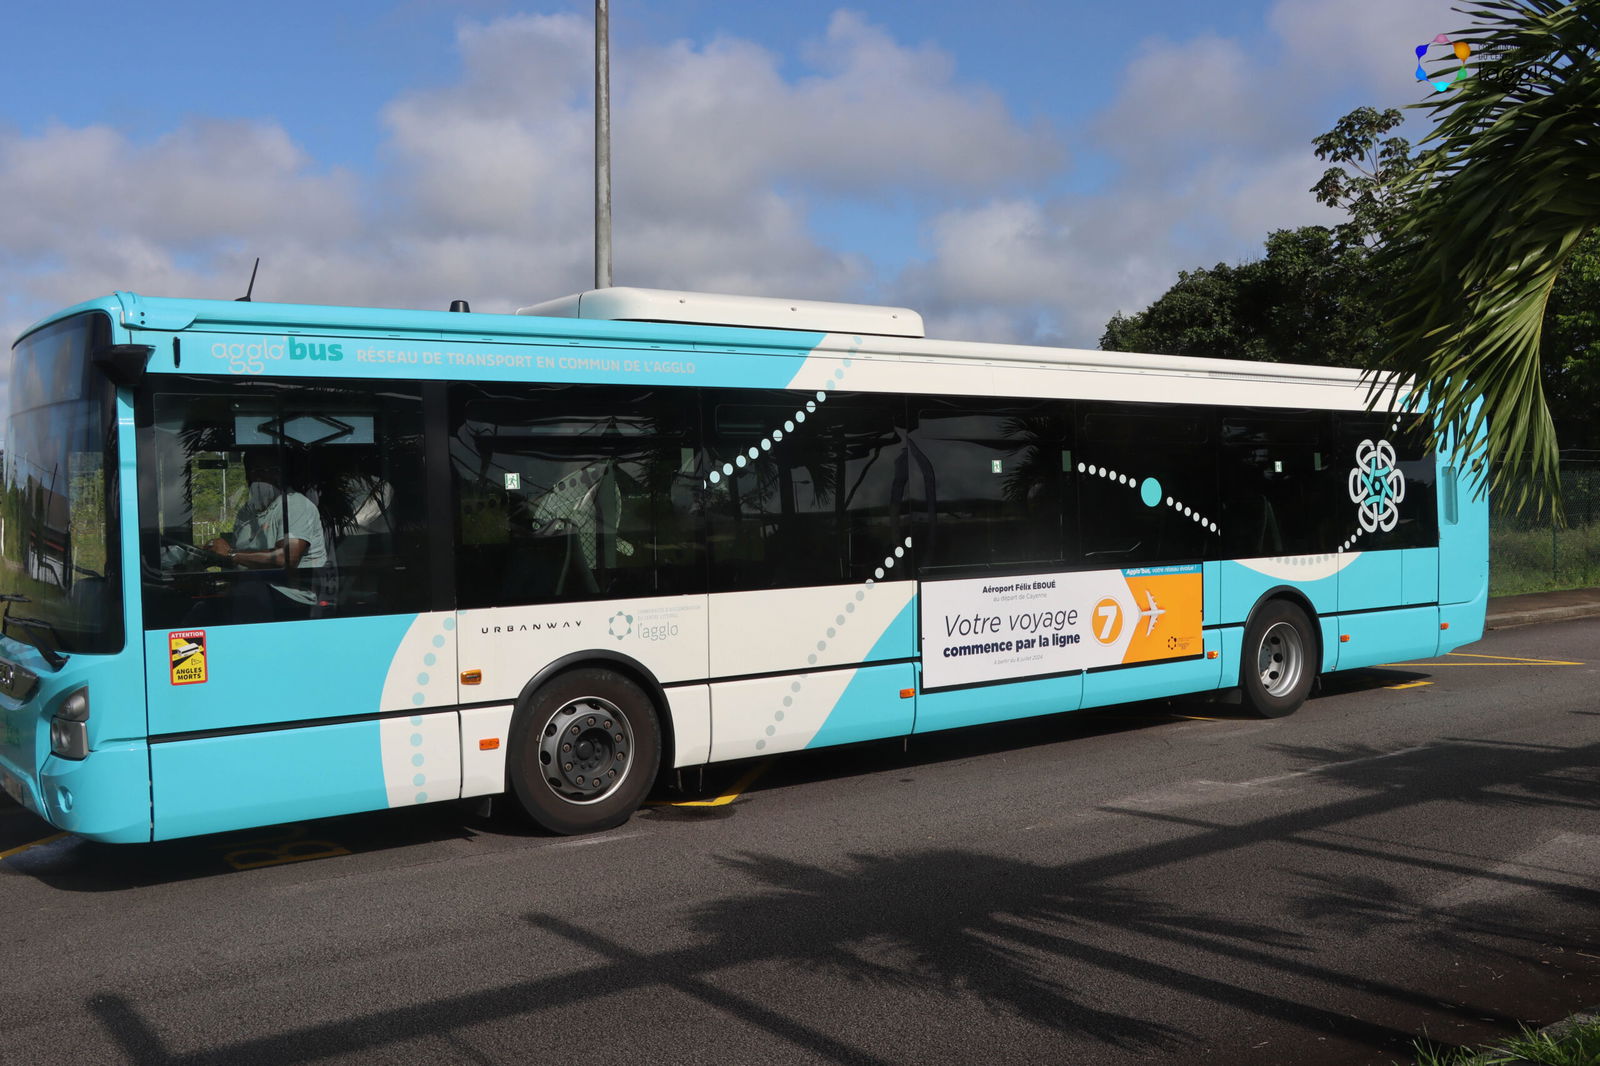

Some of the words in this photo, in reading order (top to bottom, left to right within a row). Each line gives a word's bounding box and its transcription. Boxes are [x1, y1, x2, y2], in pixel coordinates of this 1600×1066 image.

[356, 347, 417, 364] RÉSEAU
[422, 352, 443, 365] DE
[448, 352, 531, 368] TRANSPORT
[536, 356, 555, 369] EN
[559, 357, 620, 371] COMMUN
[623, 360, 641, 371] DE
[645, 361, 696, 374] L'AGGLO
[982, 584, 1014, 594] Aéroport
[1015, 582, 1031, 591] Félix
[1032, 579, 1056, 590] ÉBOUÉ
[481, 620, 582, 634] URBANWAY
[637, 621, 679, 641] l'agglo
[945, 613, 1001, 637] Votre
[1009, 609, 1078, 634] voyage
[1097, 605, 1118, 639] 7
[943, 640, 1013, 658] commence
[1015, 638, 1036, 652] par
[1038, 635, 1049, 648] la
[1052, 633, 1081, 648] ligne
[176, 667, 202, 675] ANGLES
